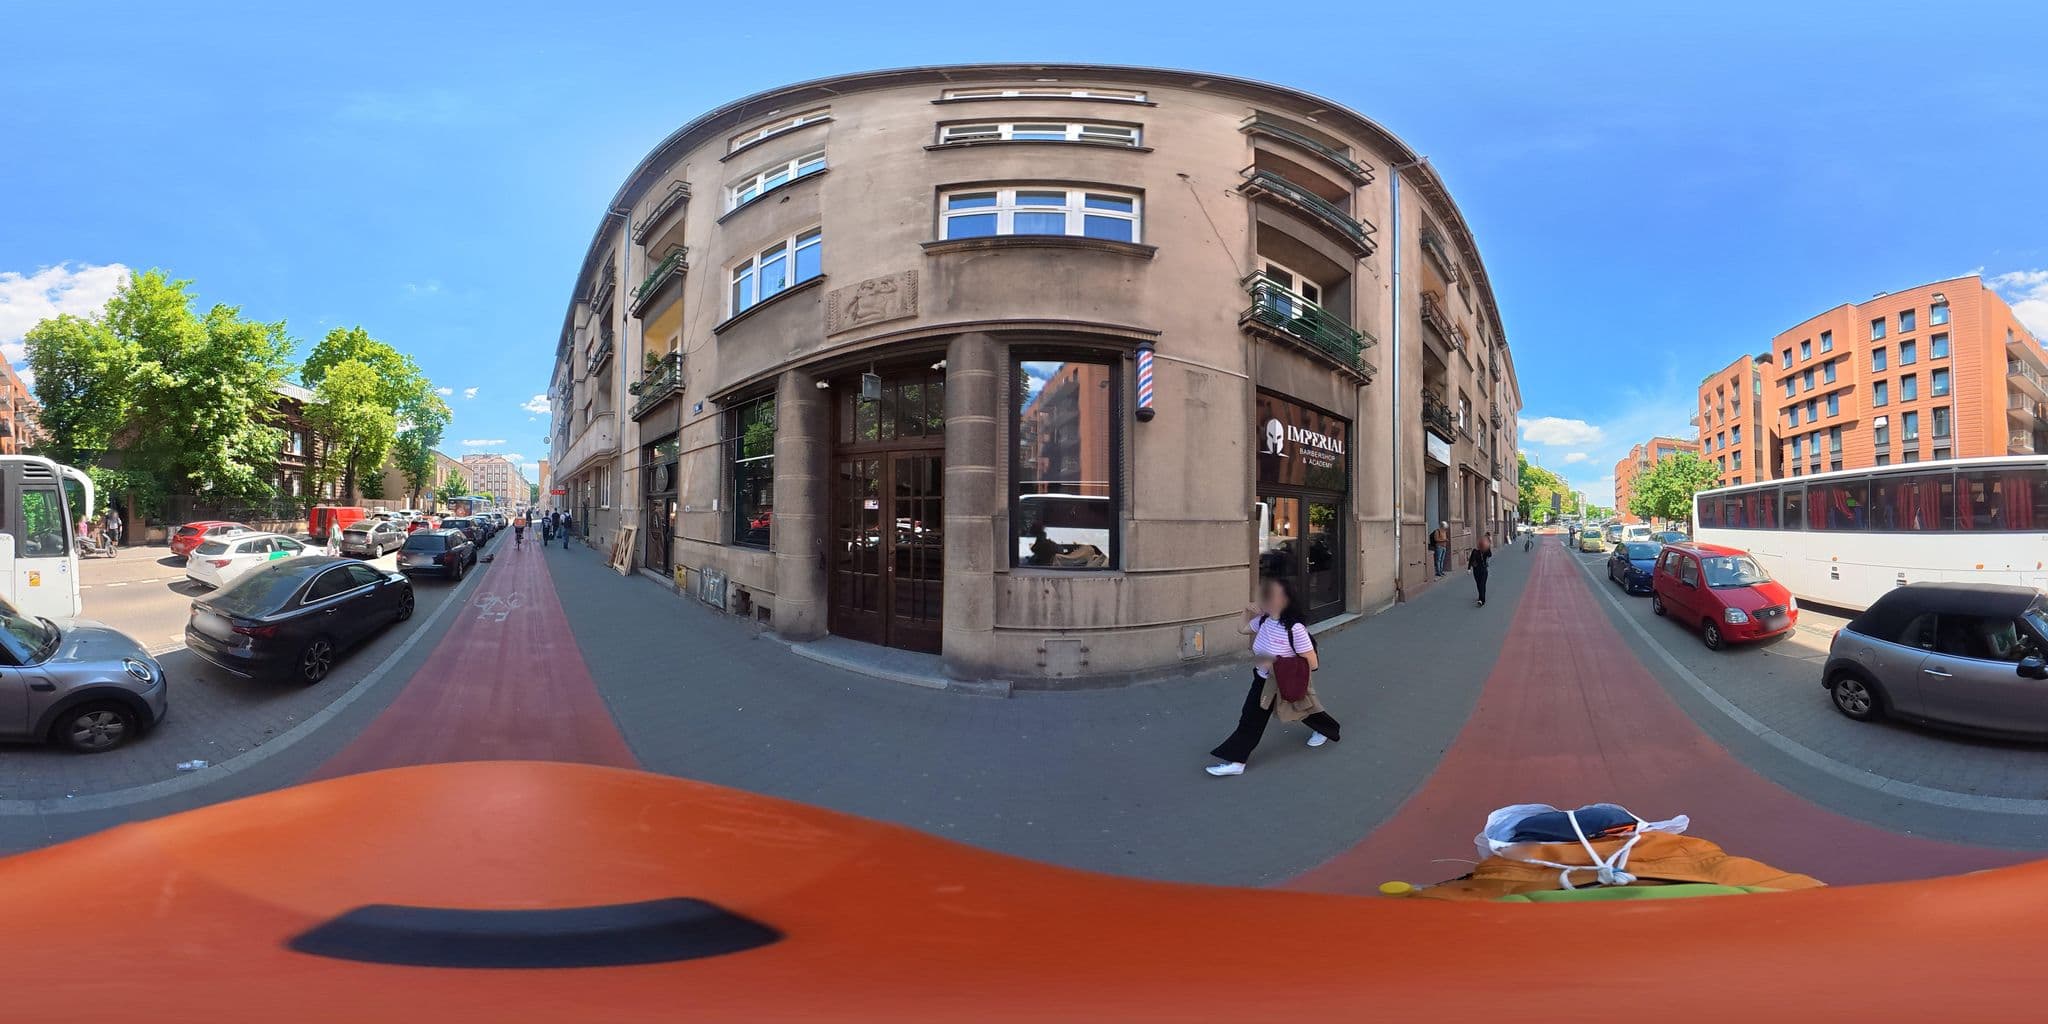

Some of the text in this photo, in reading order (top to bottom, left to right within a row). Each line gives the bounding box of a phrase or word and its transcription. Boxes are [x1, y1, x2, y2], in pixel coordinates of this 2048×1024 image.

[1287, 424, 1345, 455] IMPERIAL
[1299, 447, 1336, 461] BARBERSHOP
[1308, 459, 1333, 468] ACADEMY
